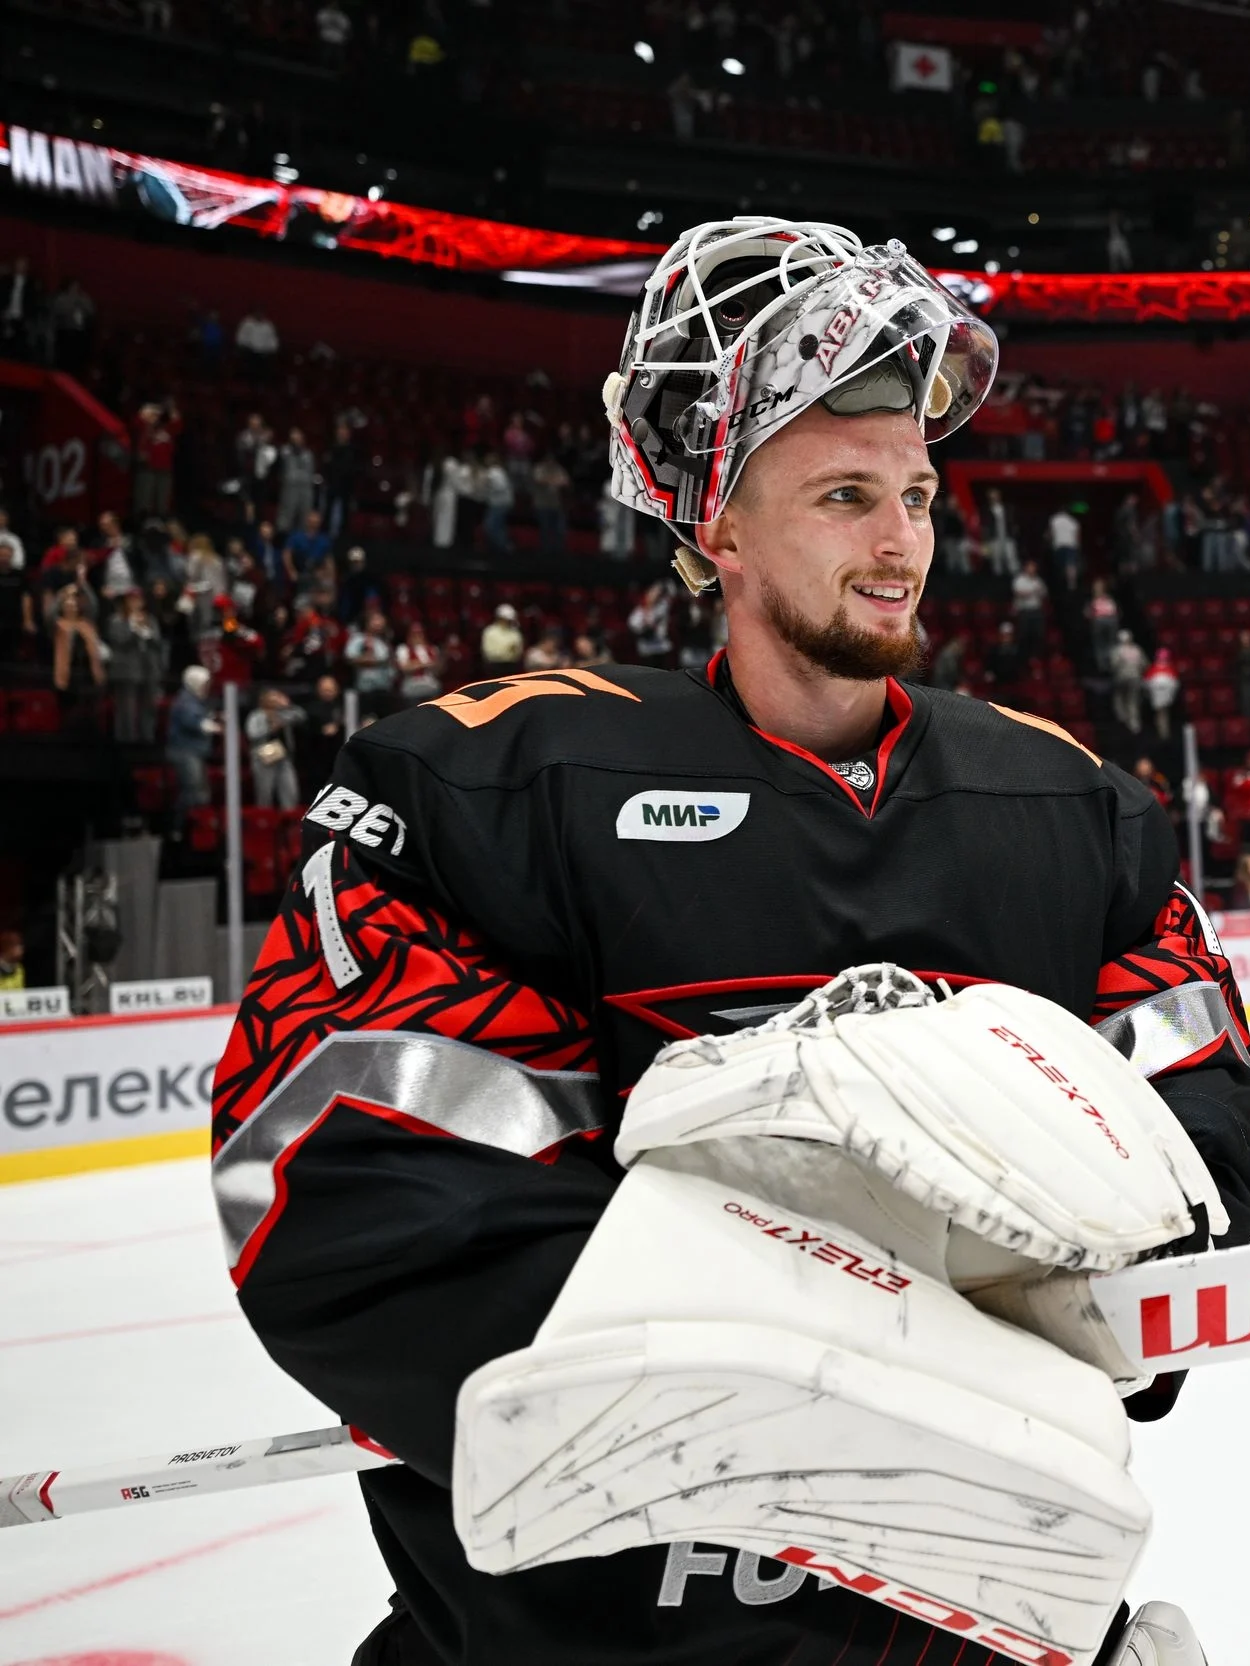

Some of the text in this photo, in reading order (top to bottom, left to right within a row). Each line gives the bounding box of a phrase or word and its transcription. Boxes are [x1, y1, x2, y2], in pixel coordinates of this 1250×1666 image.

[728, 385, 795, 429] CCM
[641, 803, 721, 827] МИР
[0, 1061, 219, 1131] елек
[168, 1444, 243, 1465] PROSVETOV
[656, 1541, 841, 1607] FO
[773, 1546, 1074, 1666] CCM
